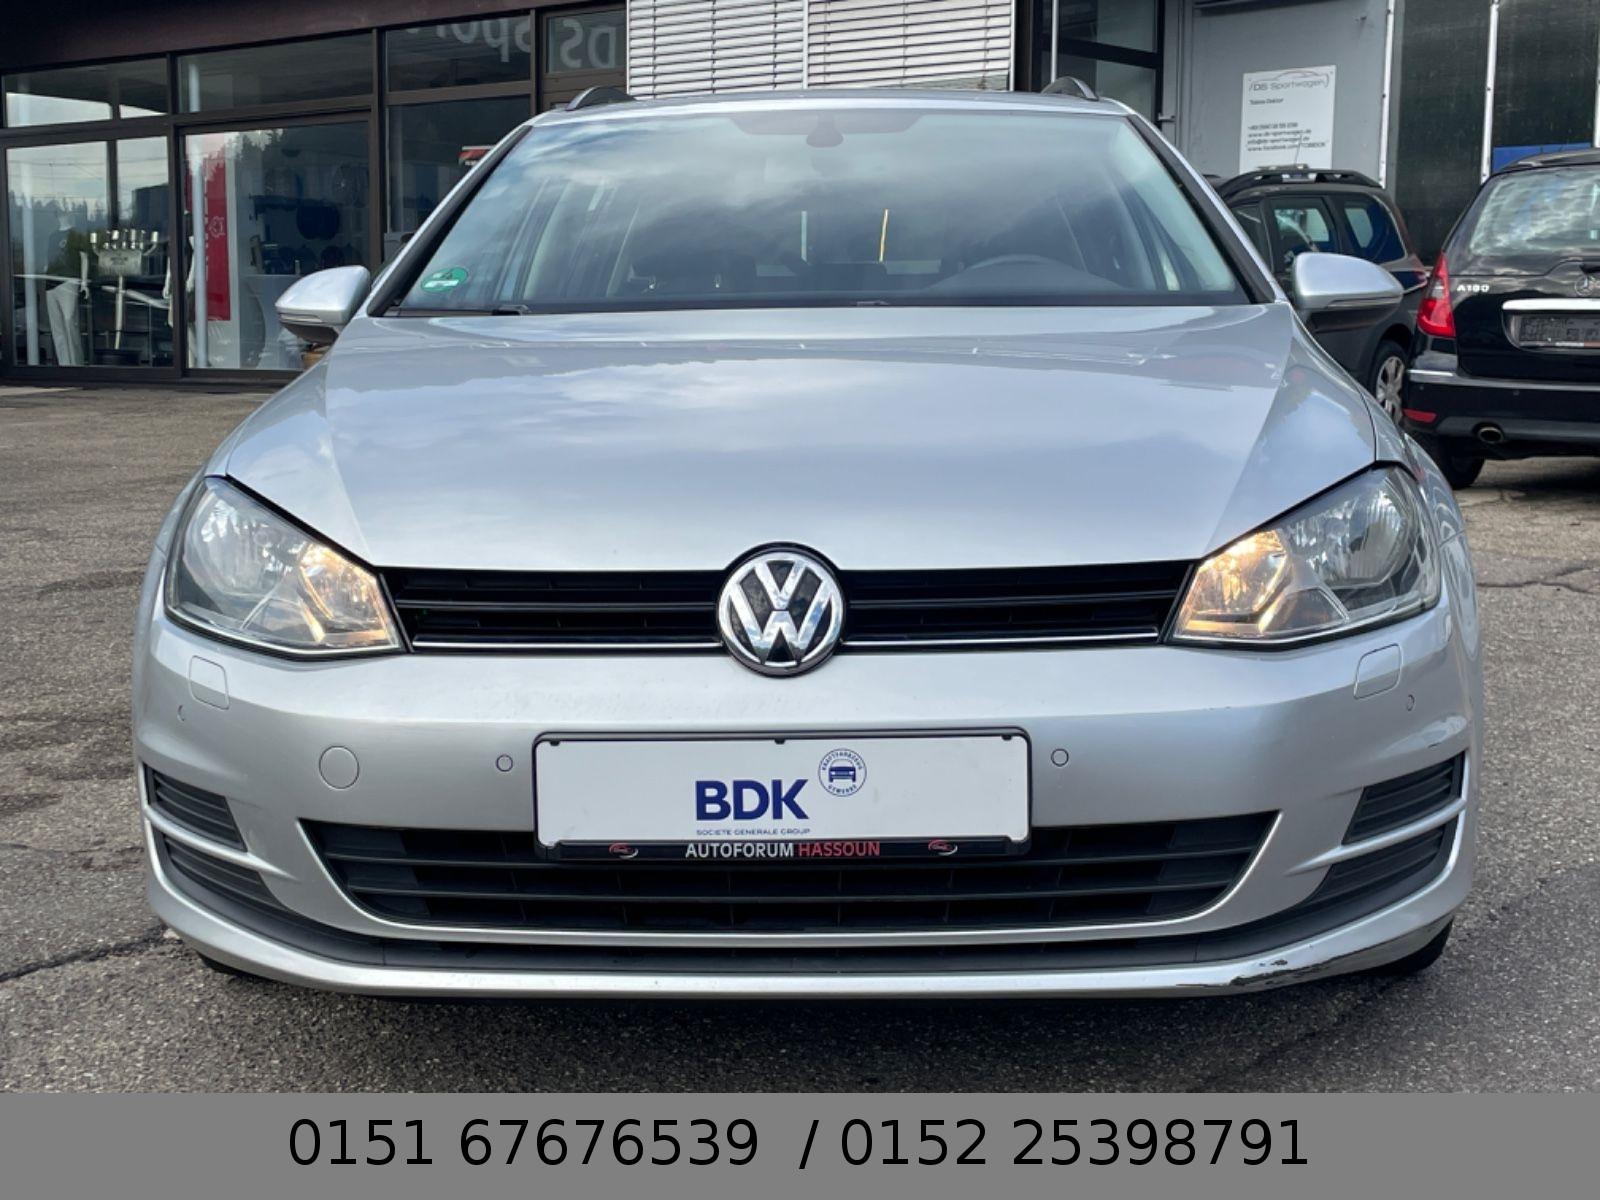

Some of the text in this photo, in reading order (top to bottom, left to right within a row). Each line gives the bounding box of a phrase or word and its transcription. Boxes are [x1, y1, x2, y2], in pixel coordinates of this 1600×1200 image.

[722, 554, 840, 665] VW
[695, 779, 810, 821] BDK
[780, 827, 811, 835] GROUP
[685, 841, 880, 858] AUTOFORUM HASSOUN
